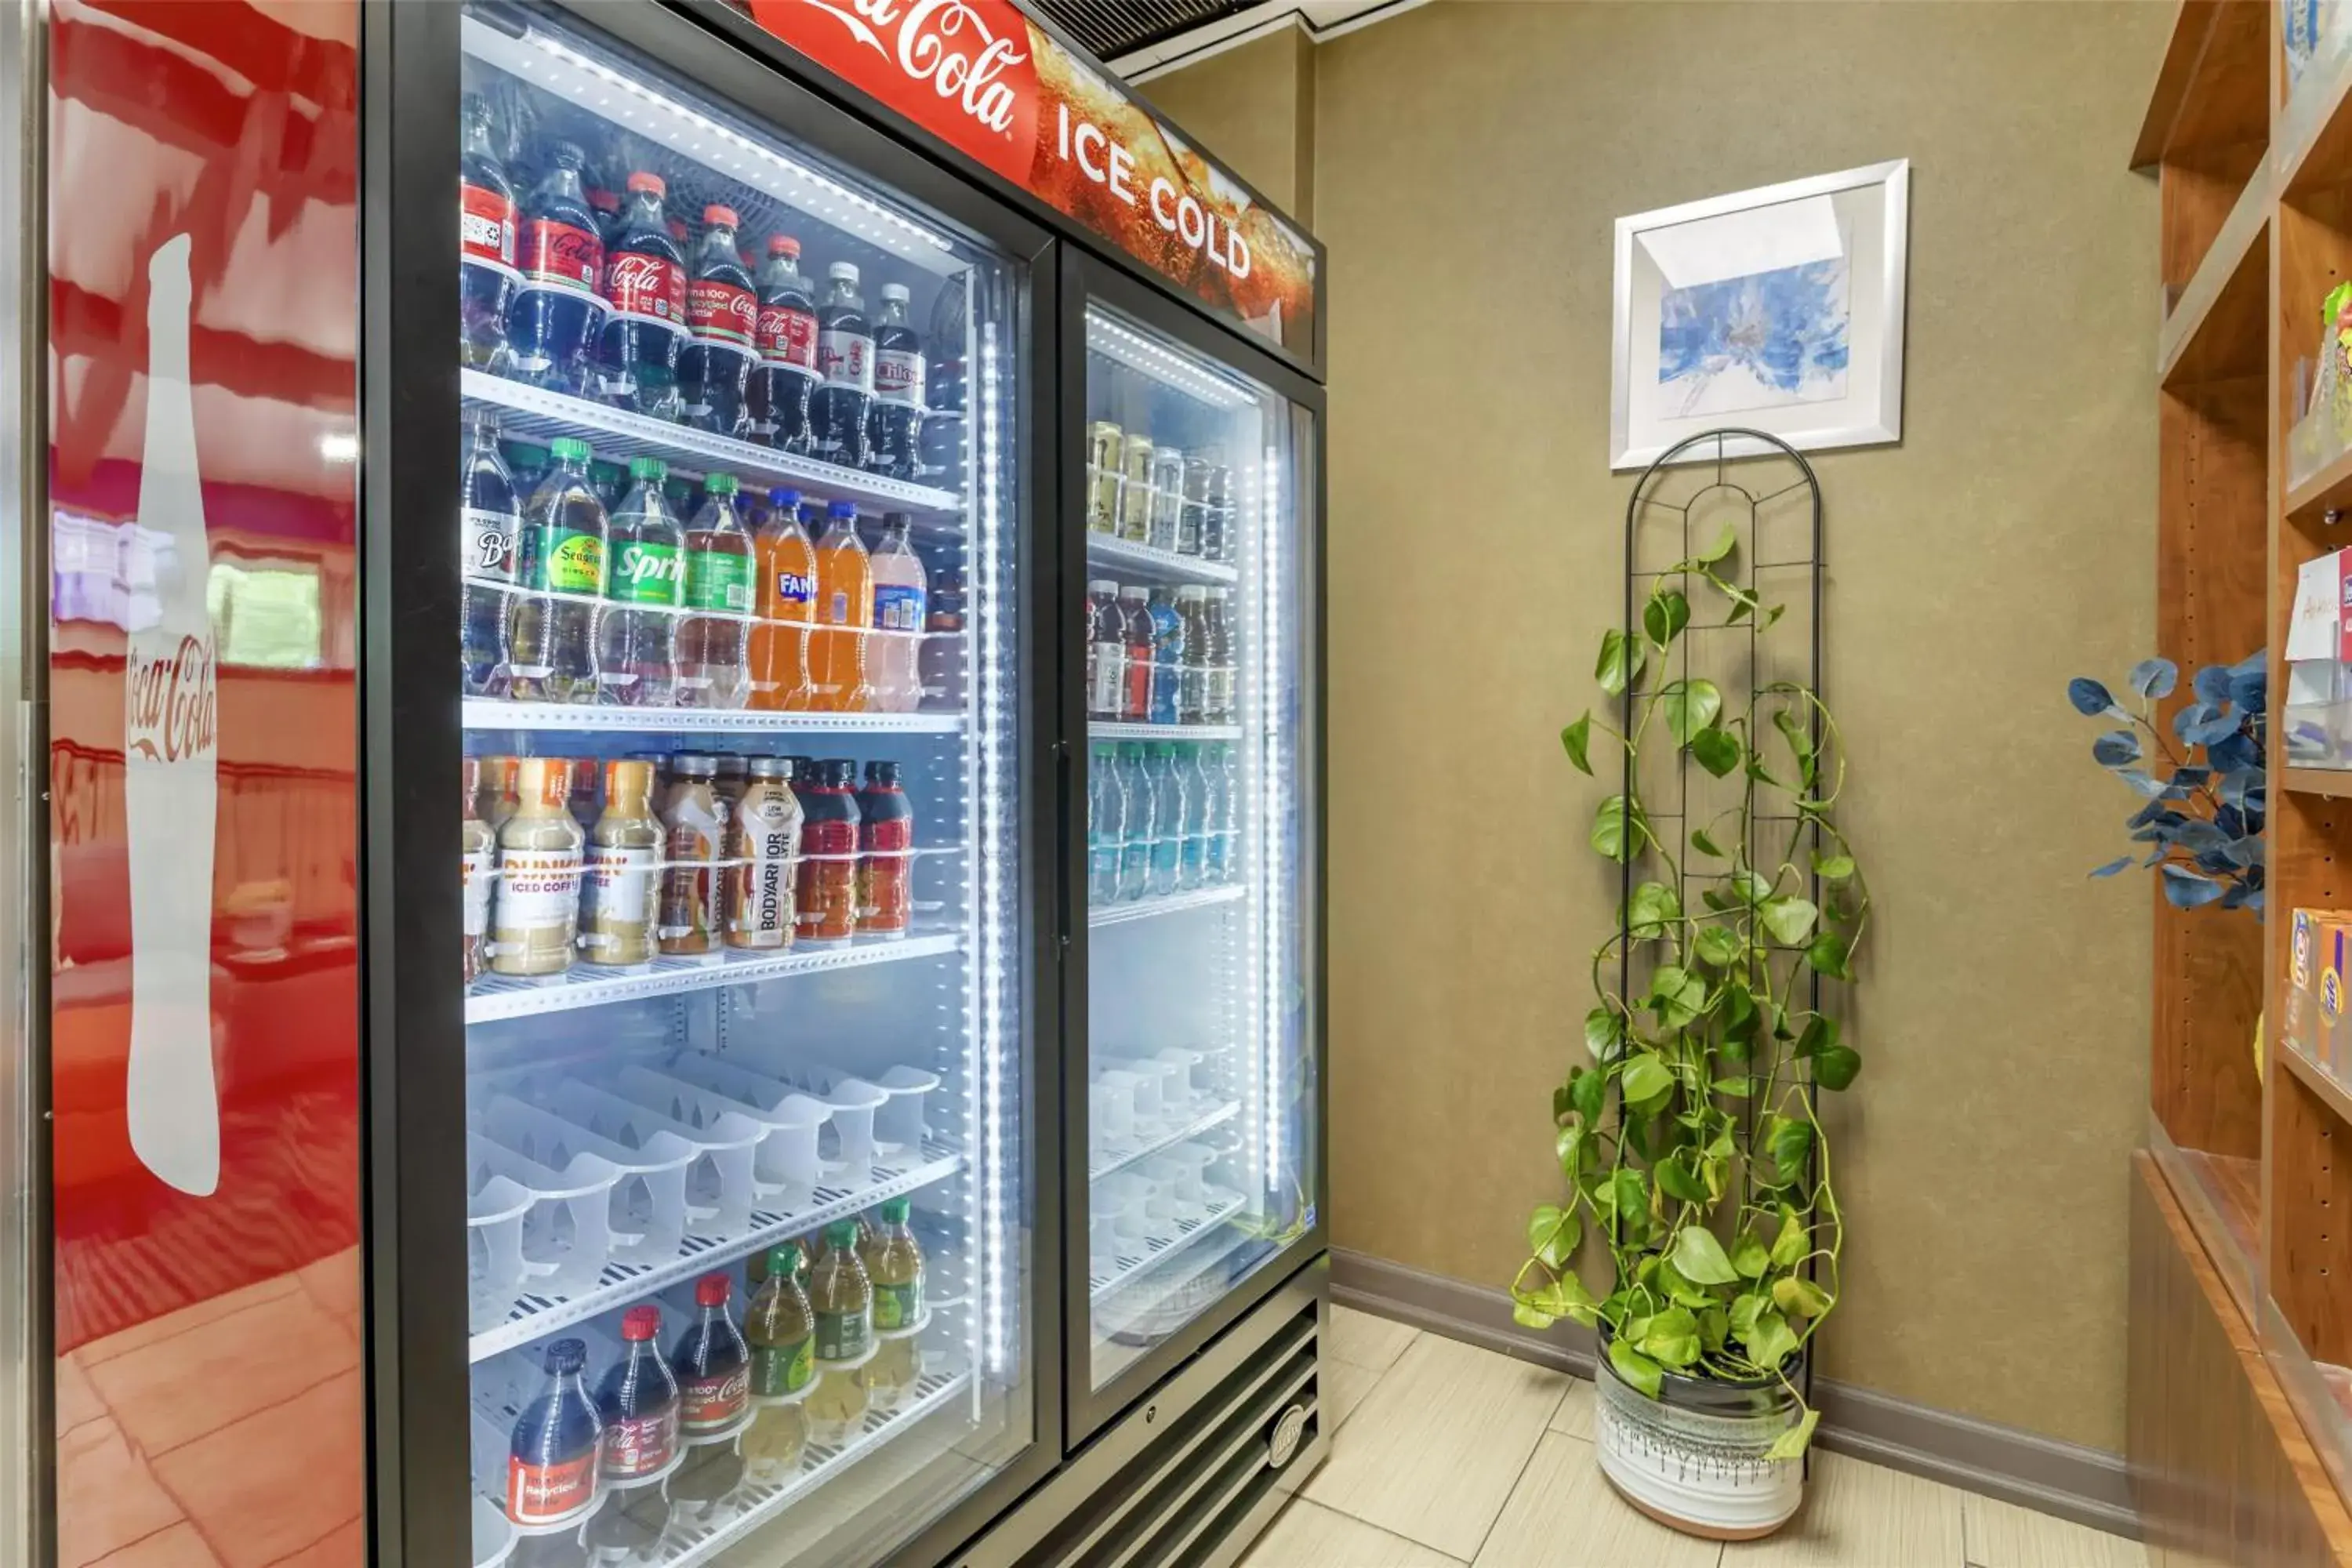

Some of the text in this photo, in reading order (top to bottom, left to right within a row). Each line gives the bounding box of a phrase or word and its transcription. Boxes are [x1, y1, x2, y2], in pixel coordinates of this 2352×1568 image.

[1058, 102, 1250, 279] ICE COLD
[612, 256, 666, 292] Cola
[512, 881, 540, 892] ICED
